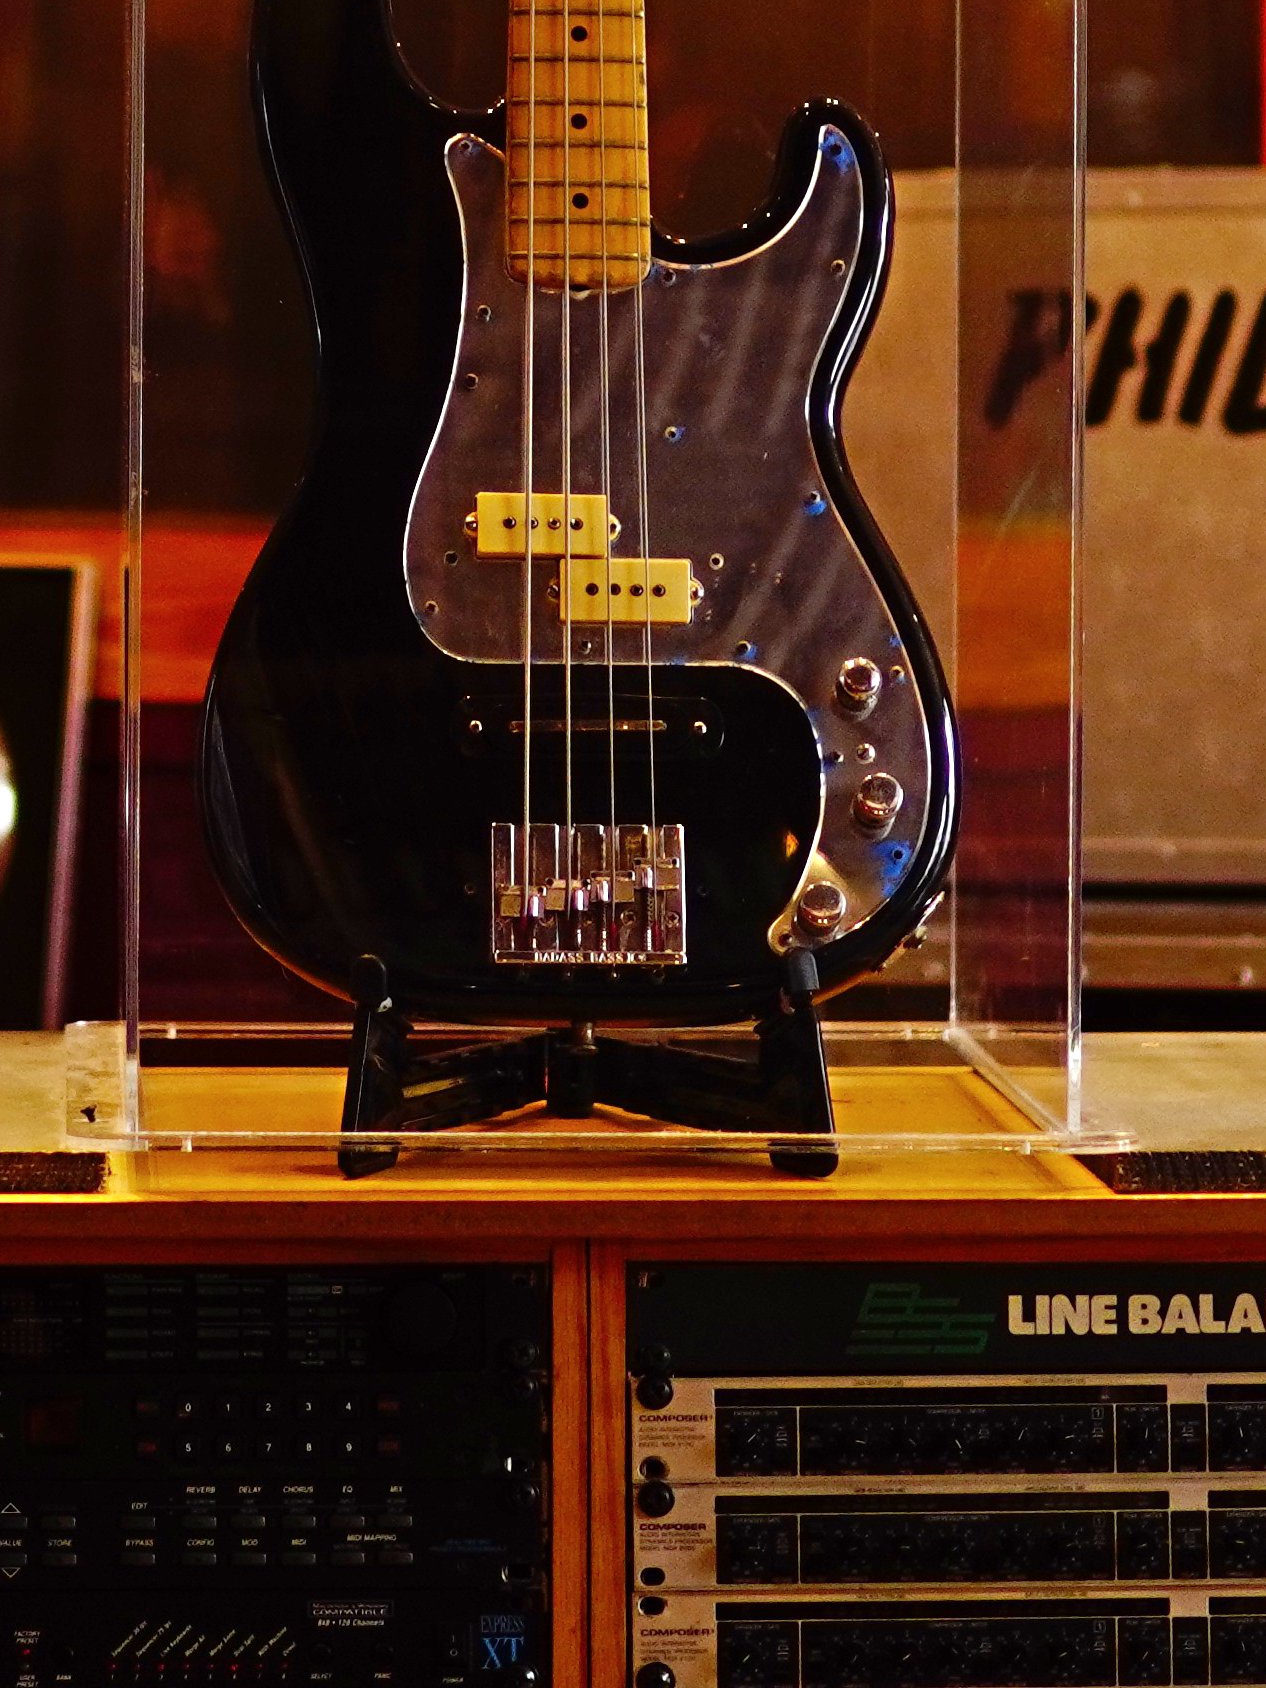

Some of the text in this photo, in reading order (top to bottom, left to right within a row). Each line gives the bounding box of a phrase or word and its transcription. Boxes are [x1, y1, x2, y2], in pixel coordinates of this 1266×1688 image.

[1007, 1294, 1118, 1336] LINE
[639, 1414, 708, 1422] COMPOSER
[186, 1485, 216, 1494] REVERB
[238, 1485, 262, 1494] DELAY
[282, 1485, 314, 1494] CHORUS
[640, 1523, 706, 1531] COMPOSER
[47, 1539, 73, 1547] STORE
[125, 1539, 154, 1547] BYPASS
[186, 1538, 215, 1547] CONFIG
[480, 1615, 526, 1633] EXPRESS
[640, 1628, 709, 1637] COMPOSER
[480, 1635, 525, 1670] XT
